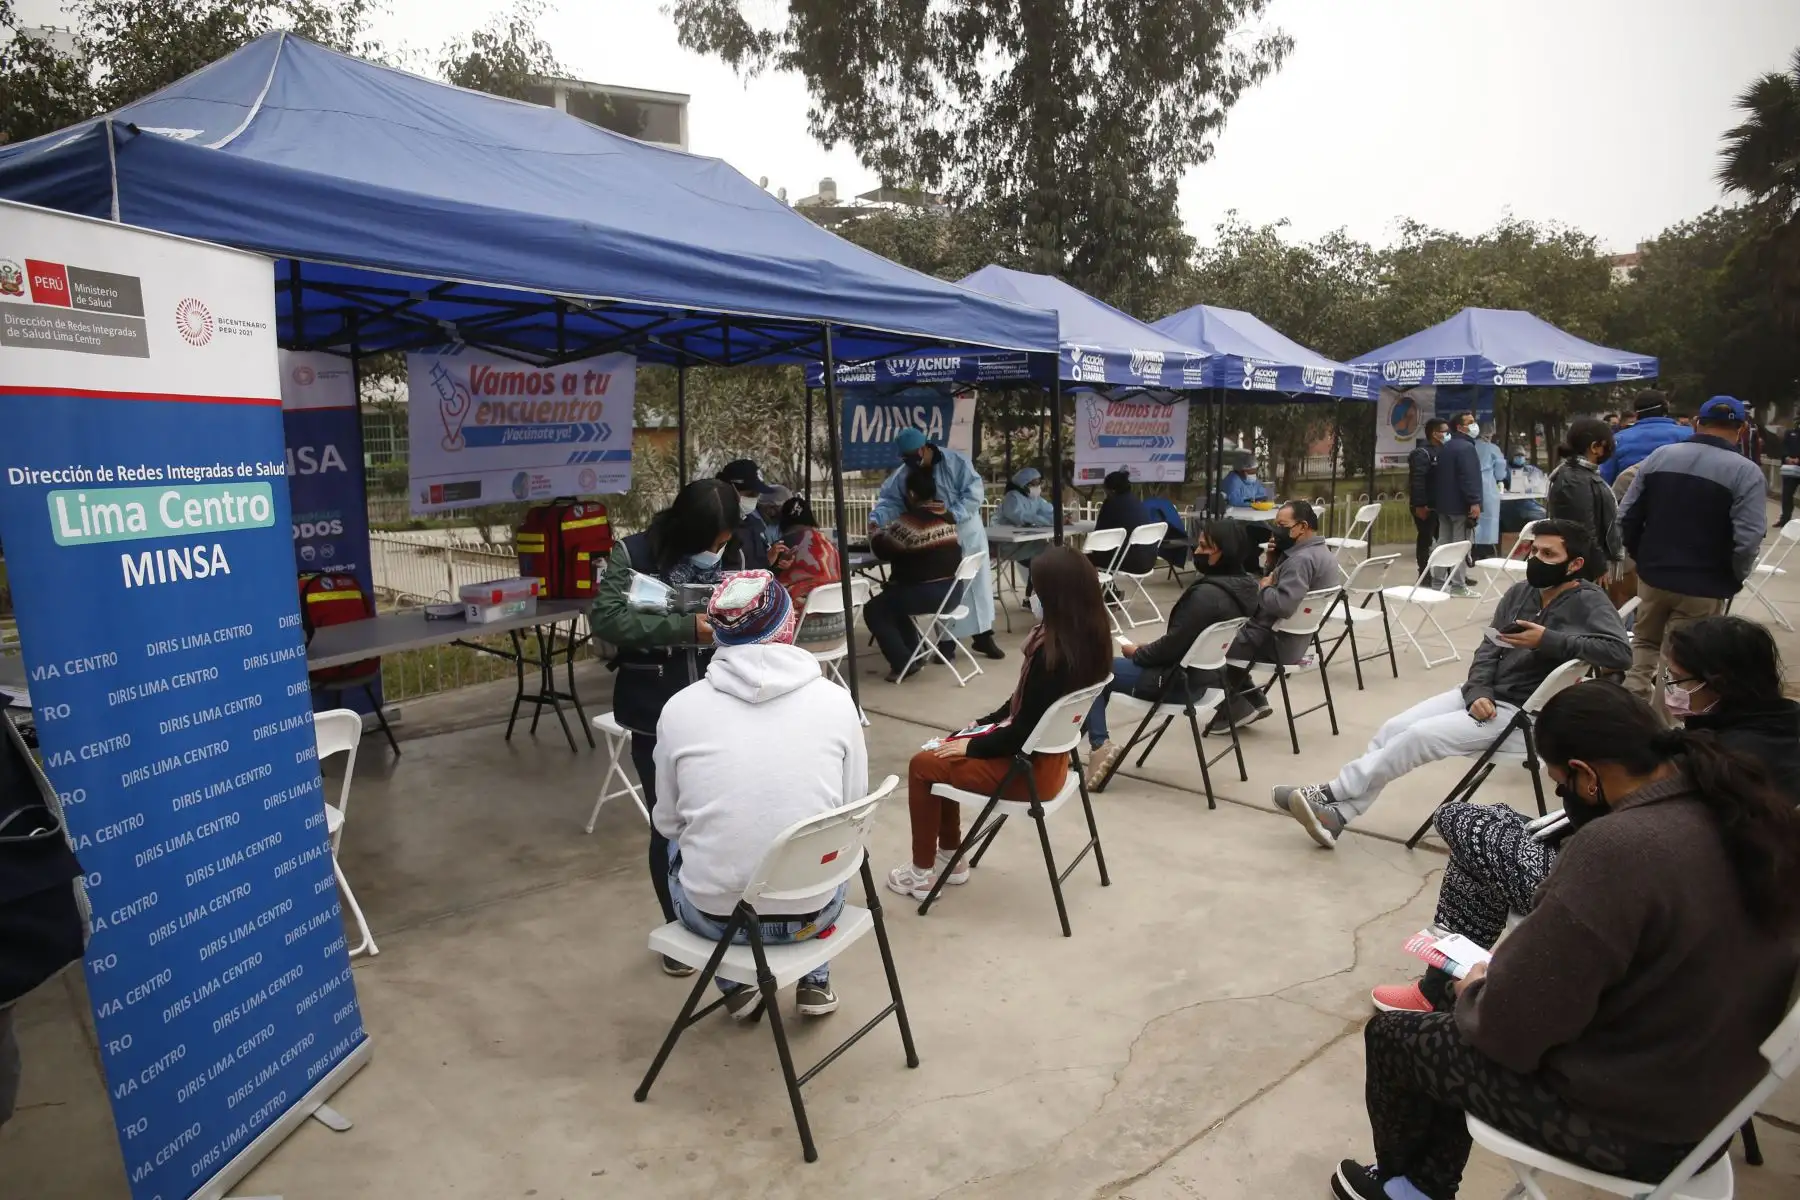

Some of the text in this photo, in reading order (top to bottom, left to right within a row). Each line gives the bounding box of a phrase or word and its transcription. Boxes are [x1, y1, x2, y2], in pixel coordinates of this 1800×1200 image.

[34, 276, 64, 291] PERÚ
[74, 282, 118, 298] Ministerio
[76, 296, 112, 308] de Salud
[4, 314, 136, 338] Dirección de Redes Integradas
[7, 327, 101, 345] de Salud Lima Centro
[218, 318, 266, 329] BICENTENARIO
[917, 357, 960, 370] ACNUR
[1400, 360, 1425, 369] UNHCR
[1400, 369, 1425, 377] ACNUR
[470, 365, 612, 396] Vamos a tu
[475, 399, 604, 425] encuentro
[1107, 402, 1174, 418] Vamos a tu
[555, 428, 572, 441] ya!
[850, 404, 943, 444] MINSA
[1105, 420, 1170, 435] encuentro
[8, 461, 284, 485] Dirección de Redes Integradas de Salud
[56, 491, 269, 538] Lima Centro
[121, 544, 230, 588] MINSA
[279, 614, 300, 628] DIRIS
[471, 607, 478, 616] 3
[147, 624, 252, 656] DIRIS LIMA CENTRO
[65, 652, 117, 675] CENTRO
[244, 654, 268, 670] DIRIS
[270, 648, 295, 663] LIMA
[108, 667, 218, 706] DIRIS LIMA CENTRO
[287, 680, 307, 696] DIRIS
[39, 704, 70, 721] RO
[160, 694, 262, 734] DIRIS LIMA CENTRO
[253, 722, 278, 741] DIRIS
[279, 715, 304, 732] LIMA
[80, 733, 130, 759] CENTRO
[296, 746, 316, 763] DIRIS
[122, 740, 229, 788] DIRIS LIMA CENTRO
[173, 764, 272, 811] DIRIS LIMA CENTRO
[264, 791, 287, 810] DIRIS
[289, 781, 312, 799] LIMA
[96, 813, 144, 843] CENTRO
[135, 812, 239, 867] DIRIS LIMA CENTRO
[186, 832, 282, 887] DIRIS LIMA CENTRO
[274, 858, 297, 878] DIRIS
[299, 846, 321, 865] LIMA
[315, 875, 334, 894] DIRIS
[111, 892, 157, 925] CENTRO
[149, 883, 251, 946] DIRIS LIMA CENTRO
[200, 899, 292, 960] DIRIS LIMA CENTRO
[285, 923, 307, 945] DIRIS
[309, 910, 331, 930] LIMA
[324, 937, 343, 958] DIRIS
[89, 954, 117, 973] RO
[126, 969, 171, 1004] CENTRO
[163, 952, 262, 1023] DIRIS LIMA CENTRO
[213, 965, 303, 1034] DIRIS LIMA CENTRO
[297, 992, 318, 1015] DIRIS
[319, 977, 340, 998] LIMA
[334, 1002, 353, 1024] DIRIS
[105, 1034, 132, 1055] RO
[141, 1044, 185, 1083] CENTRO
[178, 1024, 274, 1103] DIRIS LIMA CENTRO
[228, 1033, 314, 1108] DIRIS LIMA CENTRO
[307, 1054, 328, 1079] DIRIS
[330, 1038, 349, 1060] LIMA
[123, 1117, 147, 1139] RO
[192, 1091, 286, 1177] DIRIS LIMA CENTRO
[156, 1123, 200, 1165] CENTRO
